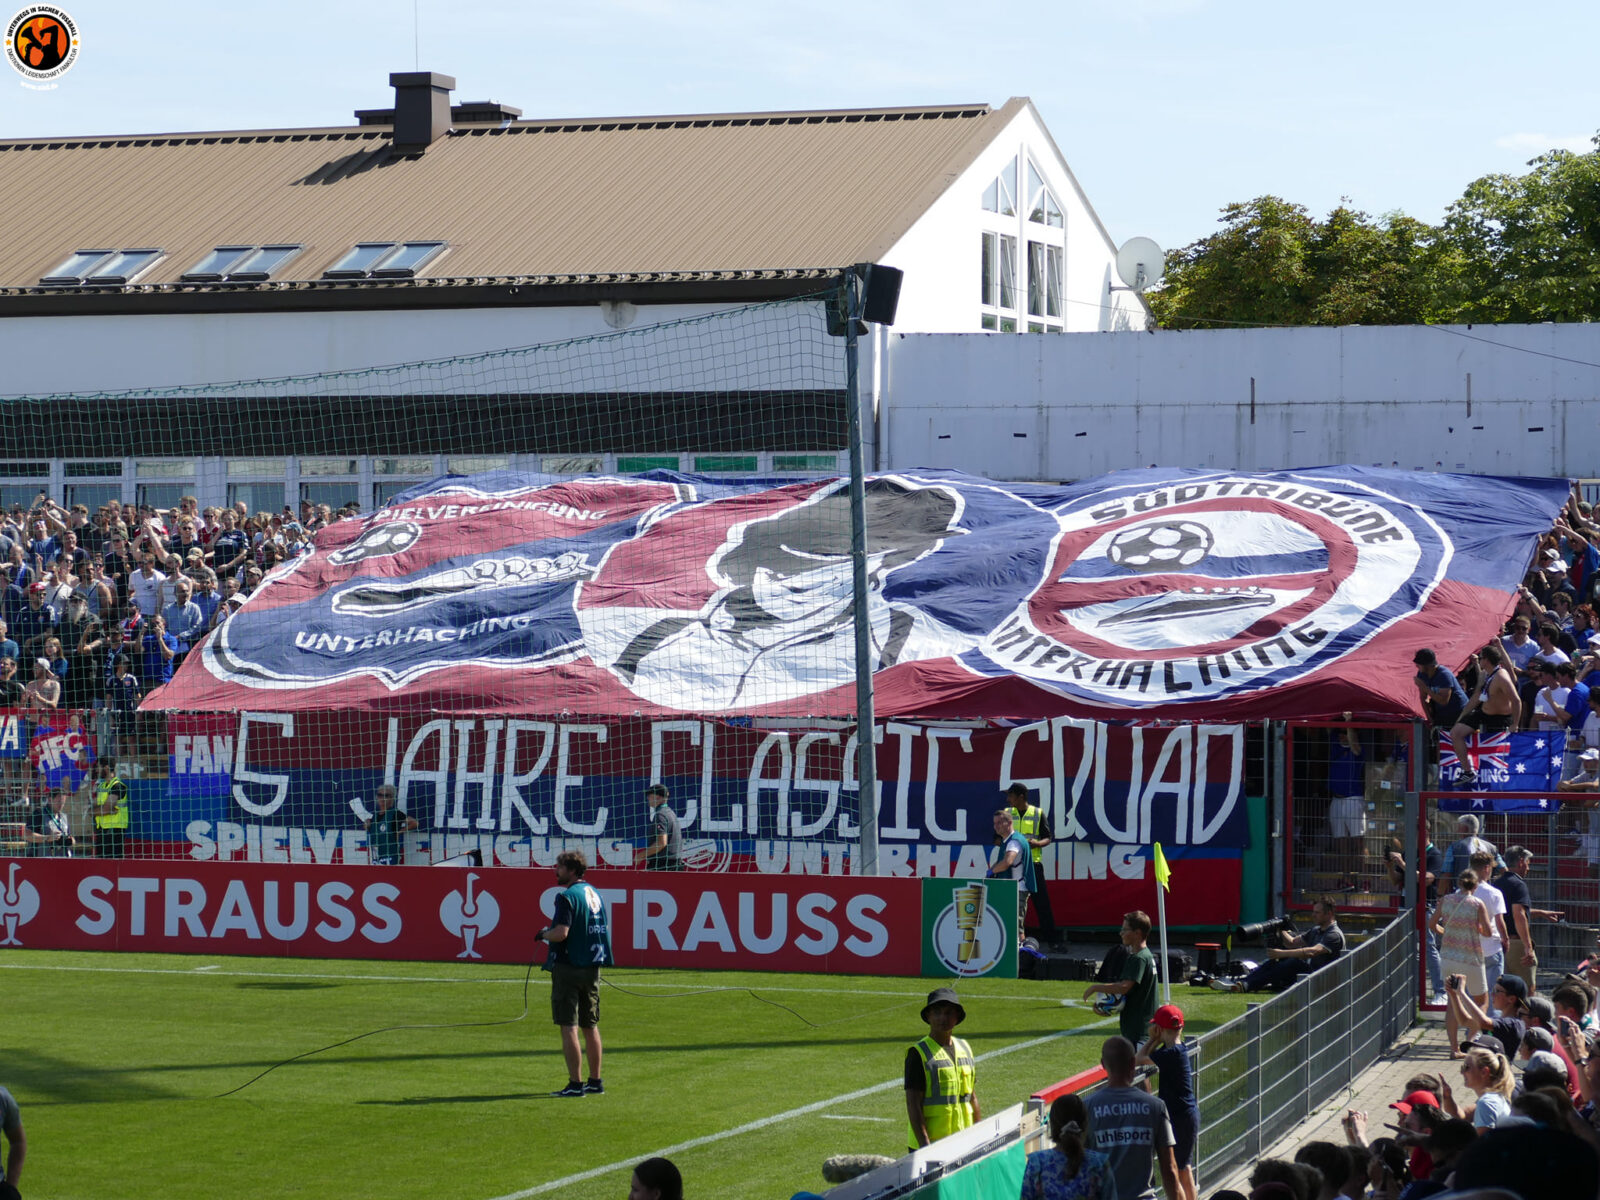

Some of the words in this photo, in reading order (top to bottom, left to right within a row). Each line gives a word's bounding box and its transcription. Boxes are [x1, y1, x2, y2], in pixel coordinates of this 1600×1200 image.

[1091, 481, 1403, 544] SÜDTRIBÜNE
[295, 616, 532, 652] UNTERHACHING
[174, 735, 233, 773] FAN
[349, 717, 608, 836] JAHRE
[650, 720, 973, 841] CLASSIC
[1000, 715, 1244, 846] SQUAD
[186, 820, 633, 867] SPIELVEEINIGUNG
[75, 875, 403, 944] STRAUSS
[1094, 1104, 1150, 1118] HACHING
[1097, 1129, 1151, 1144] uhlsport
